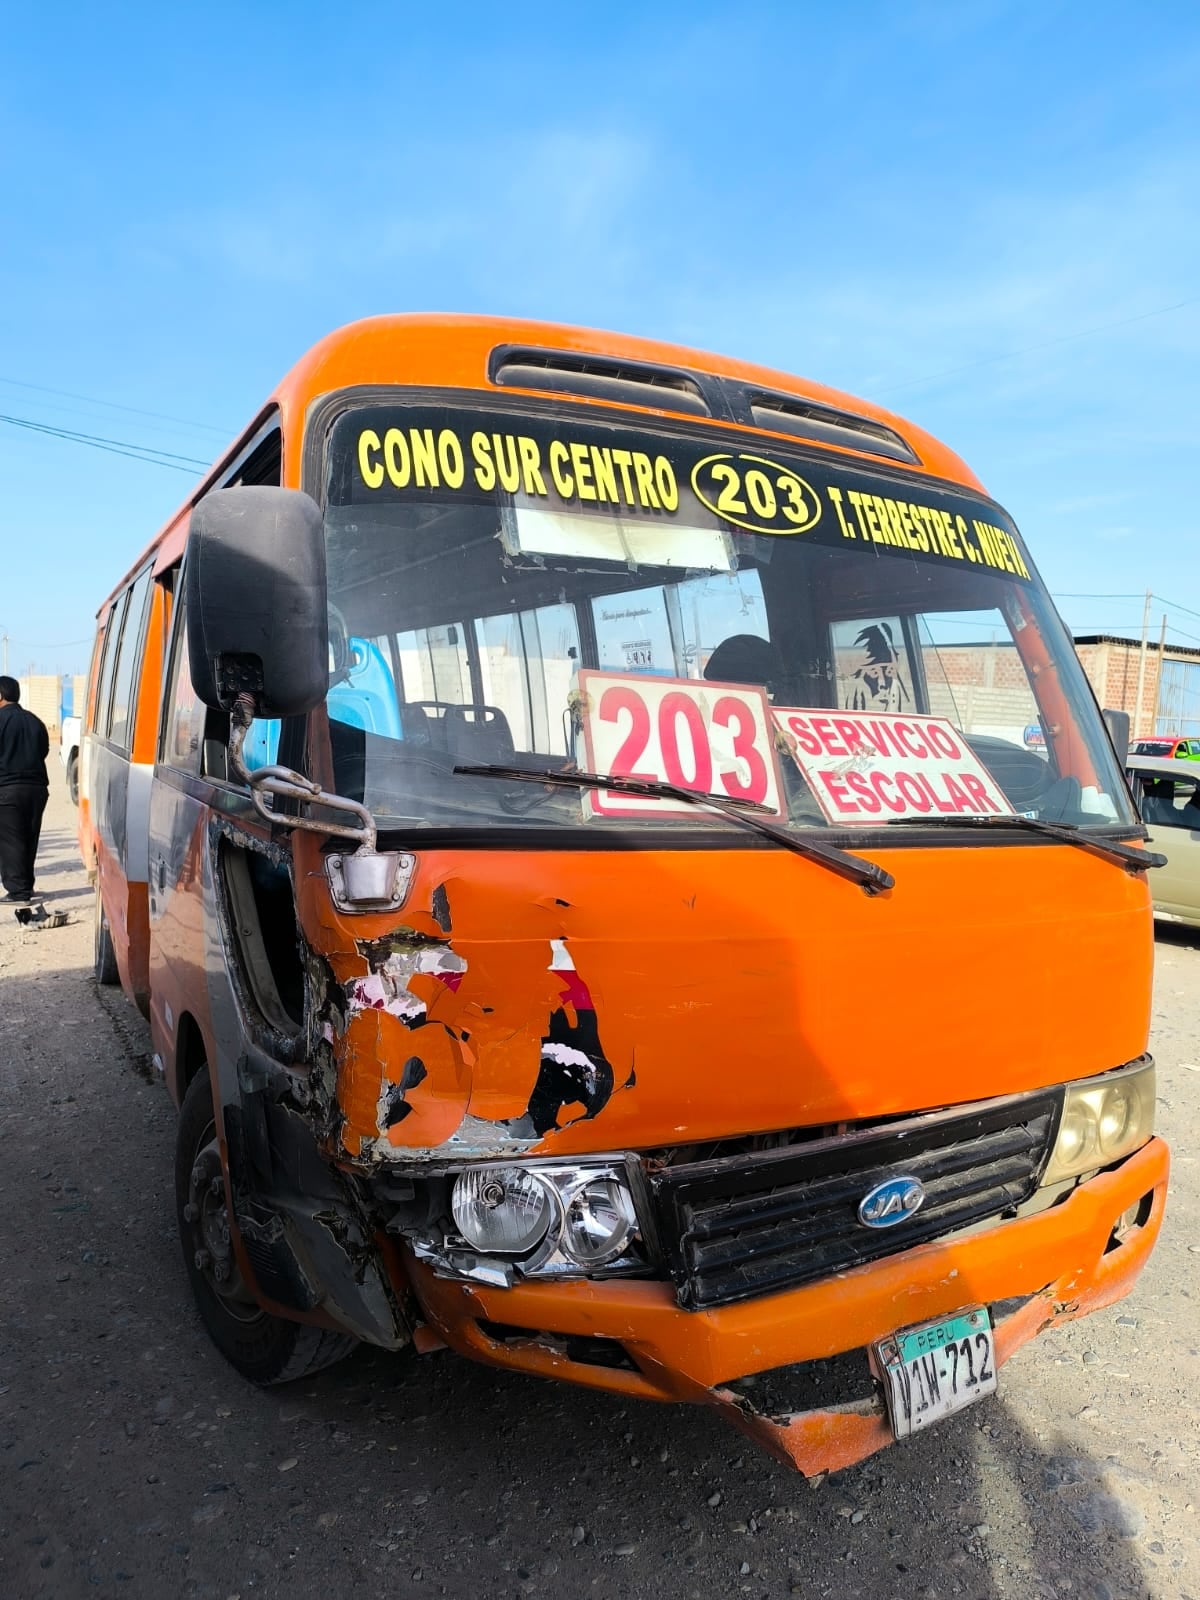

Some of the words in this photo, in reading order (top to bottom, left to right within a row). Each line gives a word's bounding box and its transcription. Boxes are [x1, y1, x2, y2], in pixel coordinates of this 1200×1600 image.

[358, 428, 464, 489] CONO
[471, 431, 547, 495] SUR
[549, 440, 679, 511] CENTRO
[711, 464, 809, 524] 203
[847, 490, 964, 560] TERRESTRE
[599, 686, 768, 804] 203
[787, 715, 962, 761] SERVICIO
[816, 770, 1001, 813] ESCOLAR
[864, 1186, 922, 1220] JAC
[917, 1325, 955, 1350] PERU
[896, 1332, 993, 1419] V1W-712
